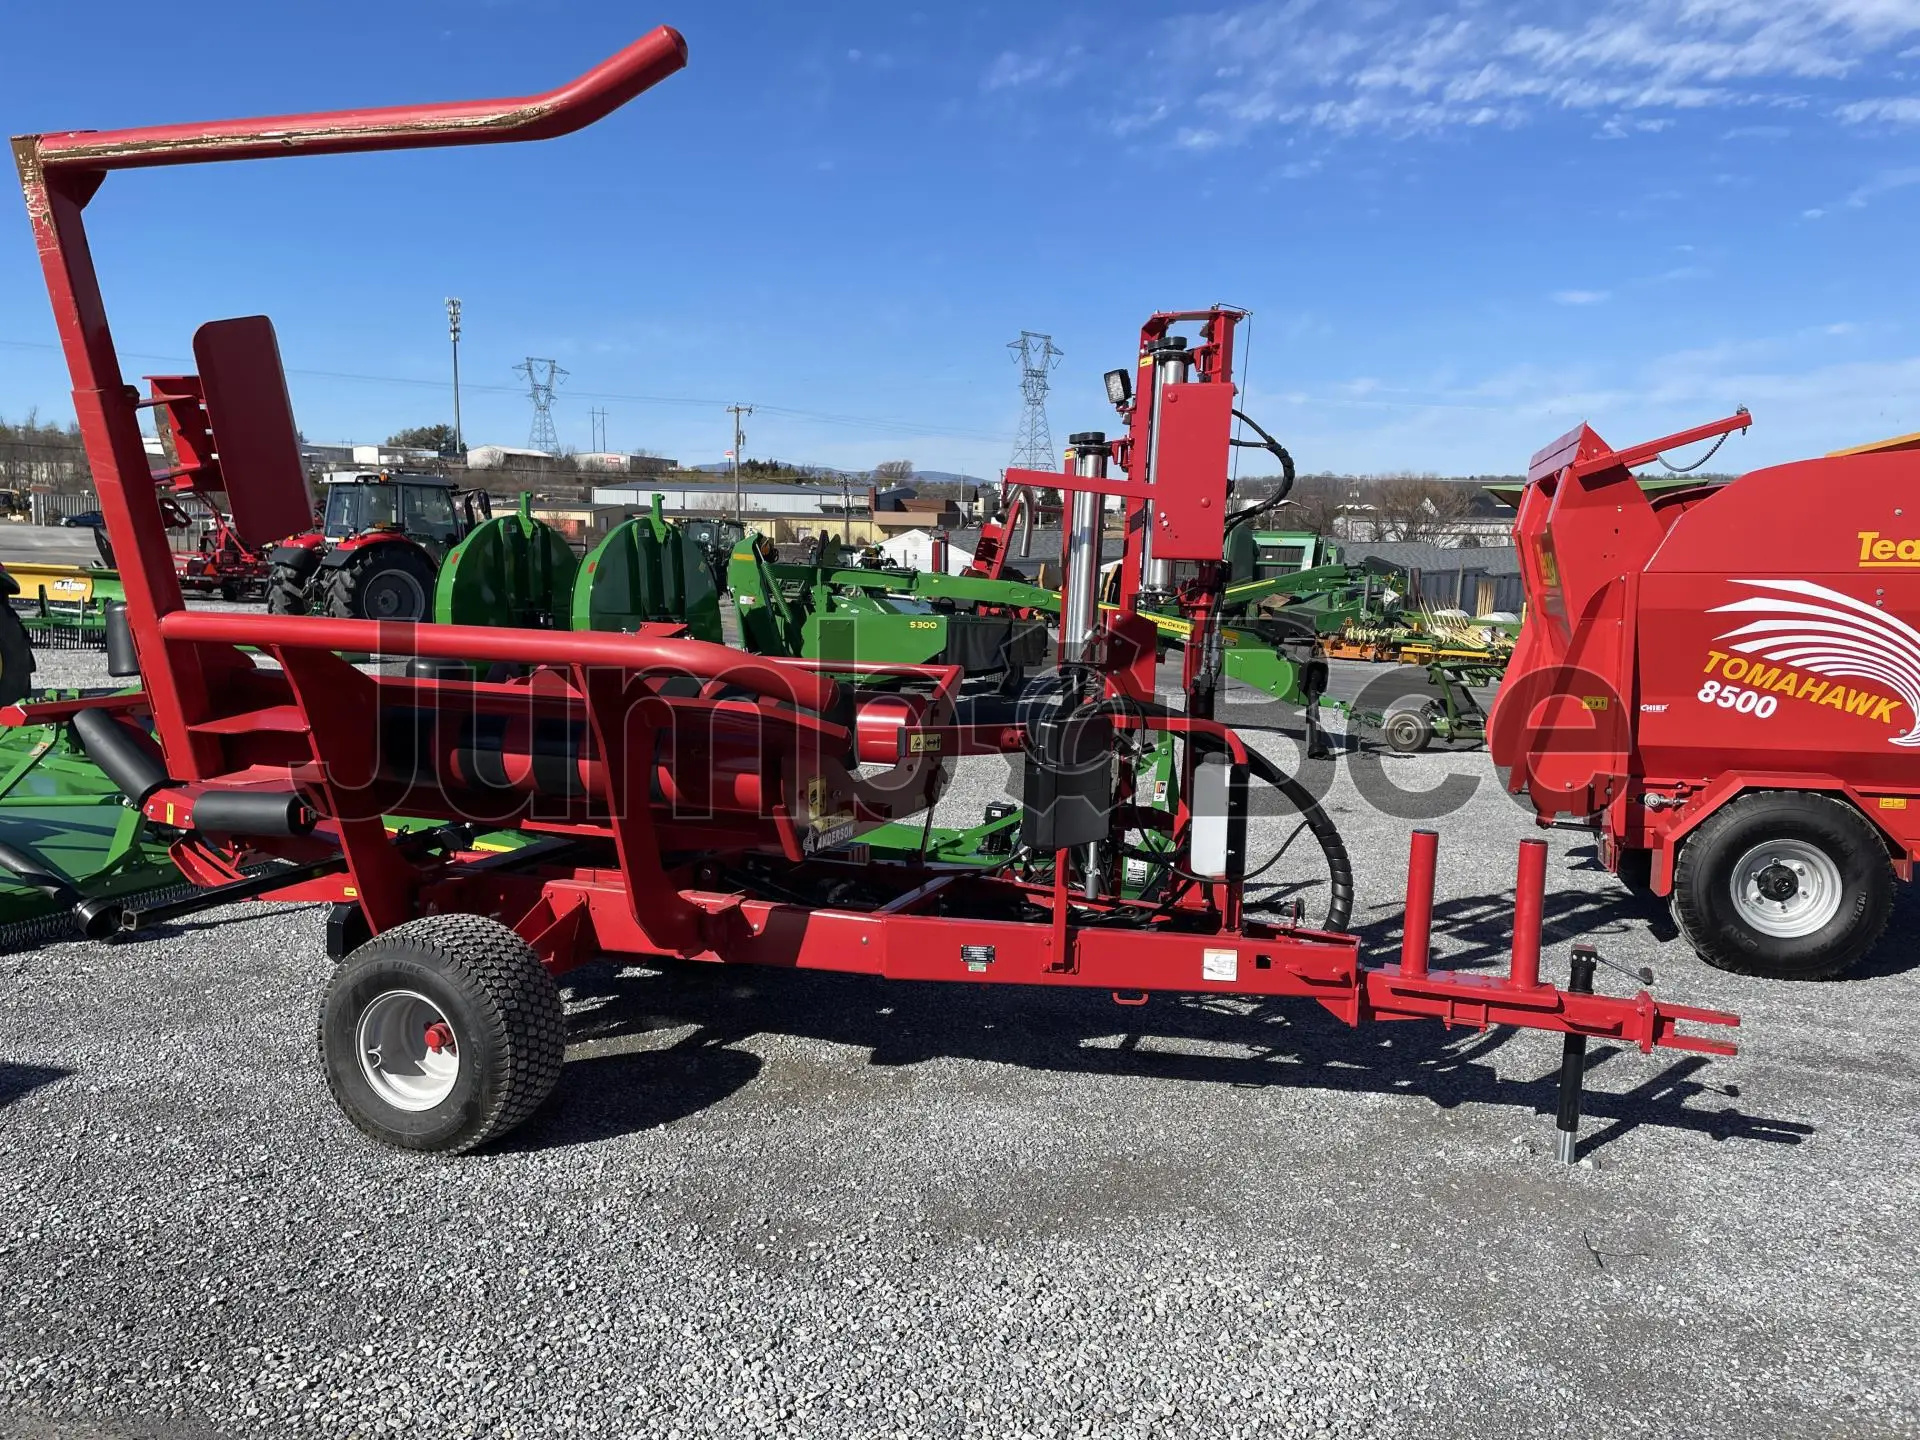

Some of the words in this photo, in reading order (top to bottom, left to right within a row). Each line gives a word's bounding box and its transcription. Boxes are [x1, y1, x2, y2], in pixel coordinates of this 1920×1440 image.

[1858, 532, 1920, 560] Tea
[1697, 680, 1778, 718] 8500
[1703, 650, 1902, 724] TOMAHAWK
[1640, 704, 1669, 712] CHIEF
[817, 823, 854, 850] ANDERSON
